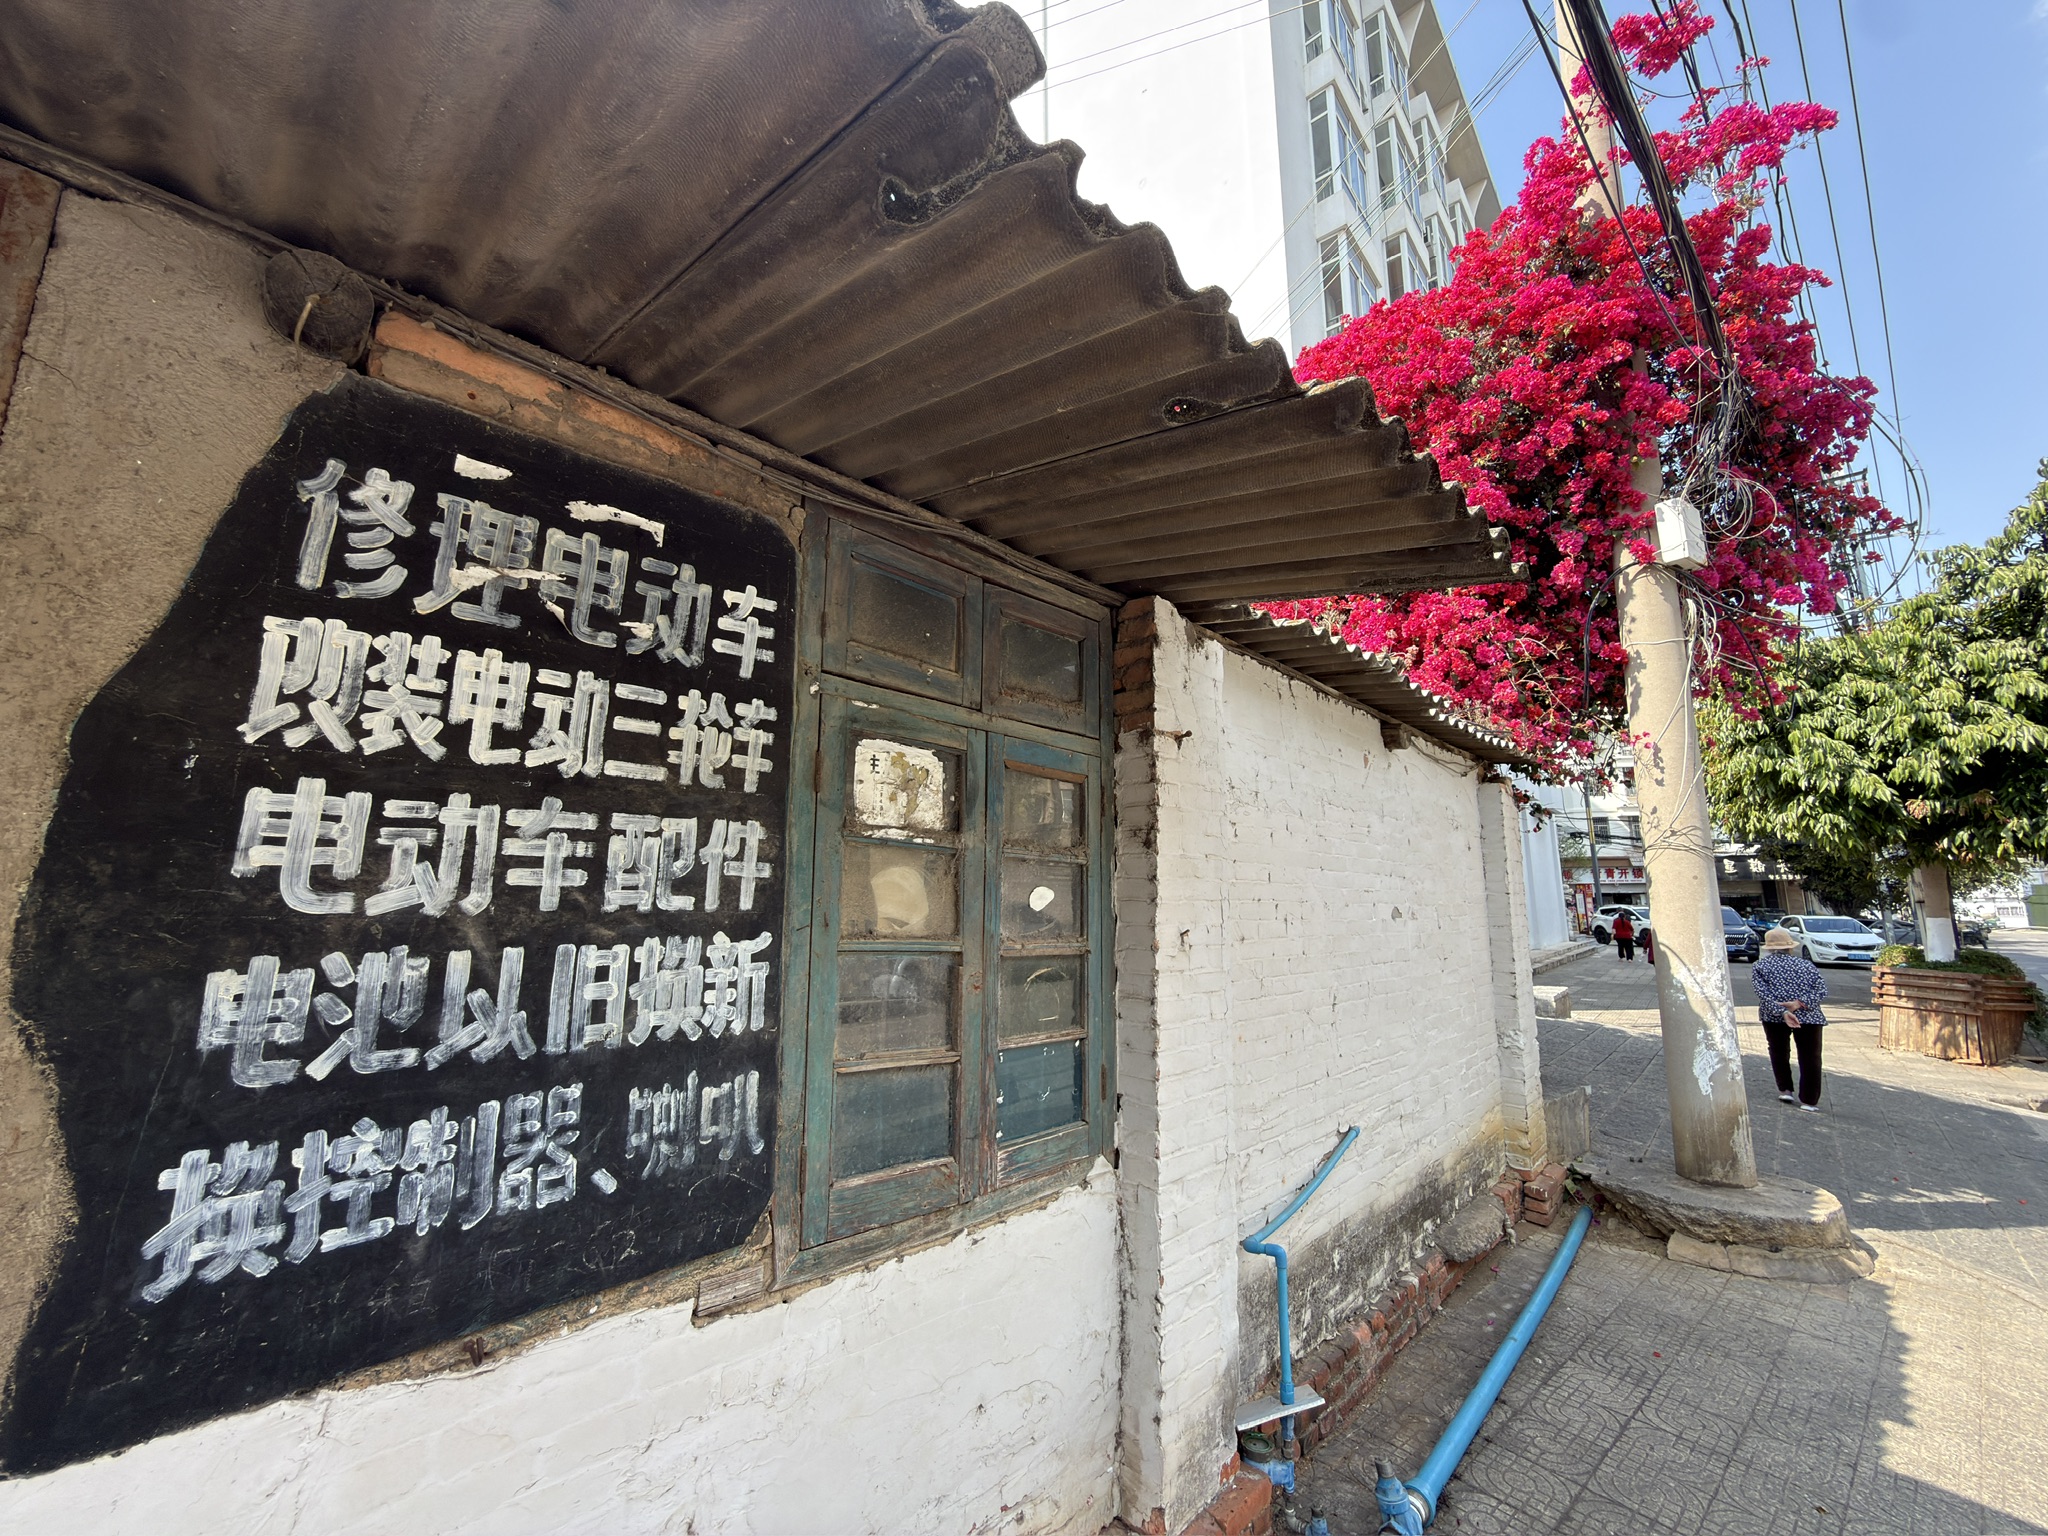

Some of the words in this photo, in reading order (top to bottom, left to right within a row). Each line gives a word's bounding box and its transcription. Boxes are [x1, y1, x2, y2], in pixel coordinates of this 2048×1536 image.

[297, 458, 777, 678] 修理电动车
[236, 615, 777, 792] 改装电动三轮车
[231, 776, 771, 916] 电动车配件
[196, 930, 772, 1088] 电池以旧换新
[140, 1069, 765, 1303] 换控制器、喇叭
